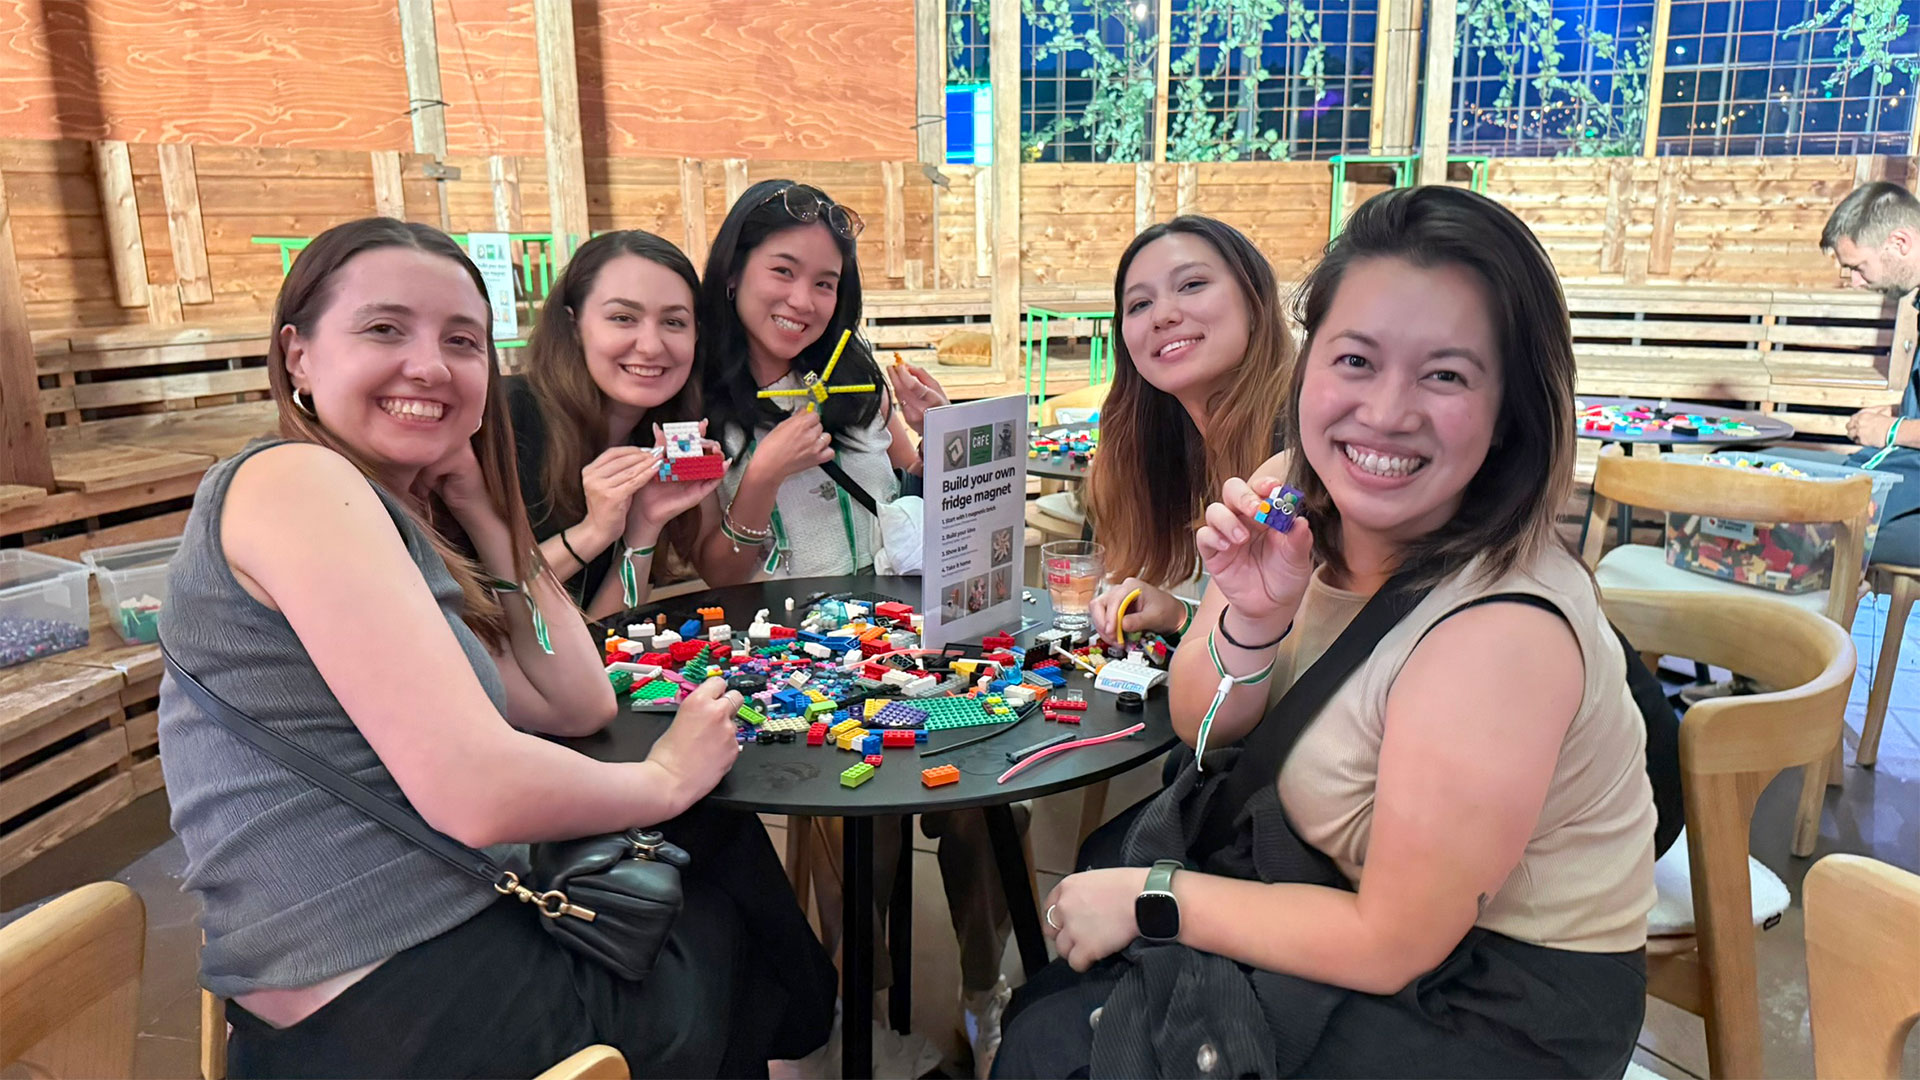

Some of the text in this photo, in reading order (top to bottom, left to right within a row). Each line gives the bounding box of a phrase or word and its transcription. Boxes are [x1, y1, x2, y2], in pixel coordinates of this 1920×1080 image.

[972, 434, 990, 448] CAFE
[943, 466, 1015, 493] Build your own
[942, 482, 1011, 511] fridge magnet
[968, 509, 985, 517] magnetic
